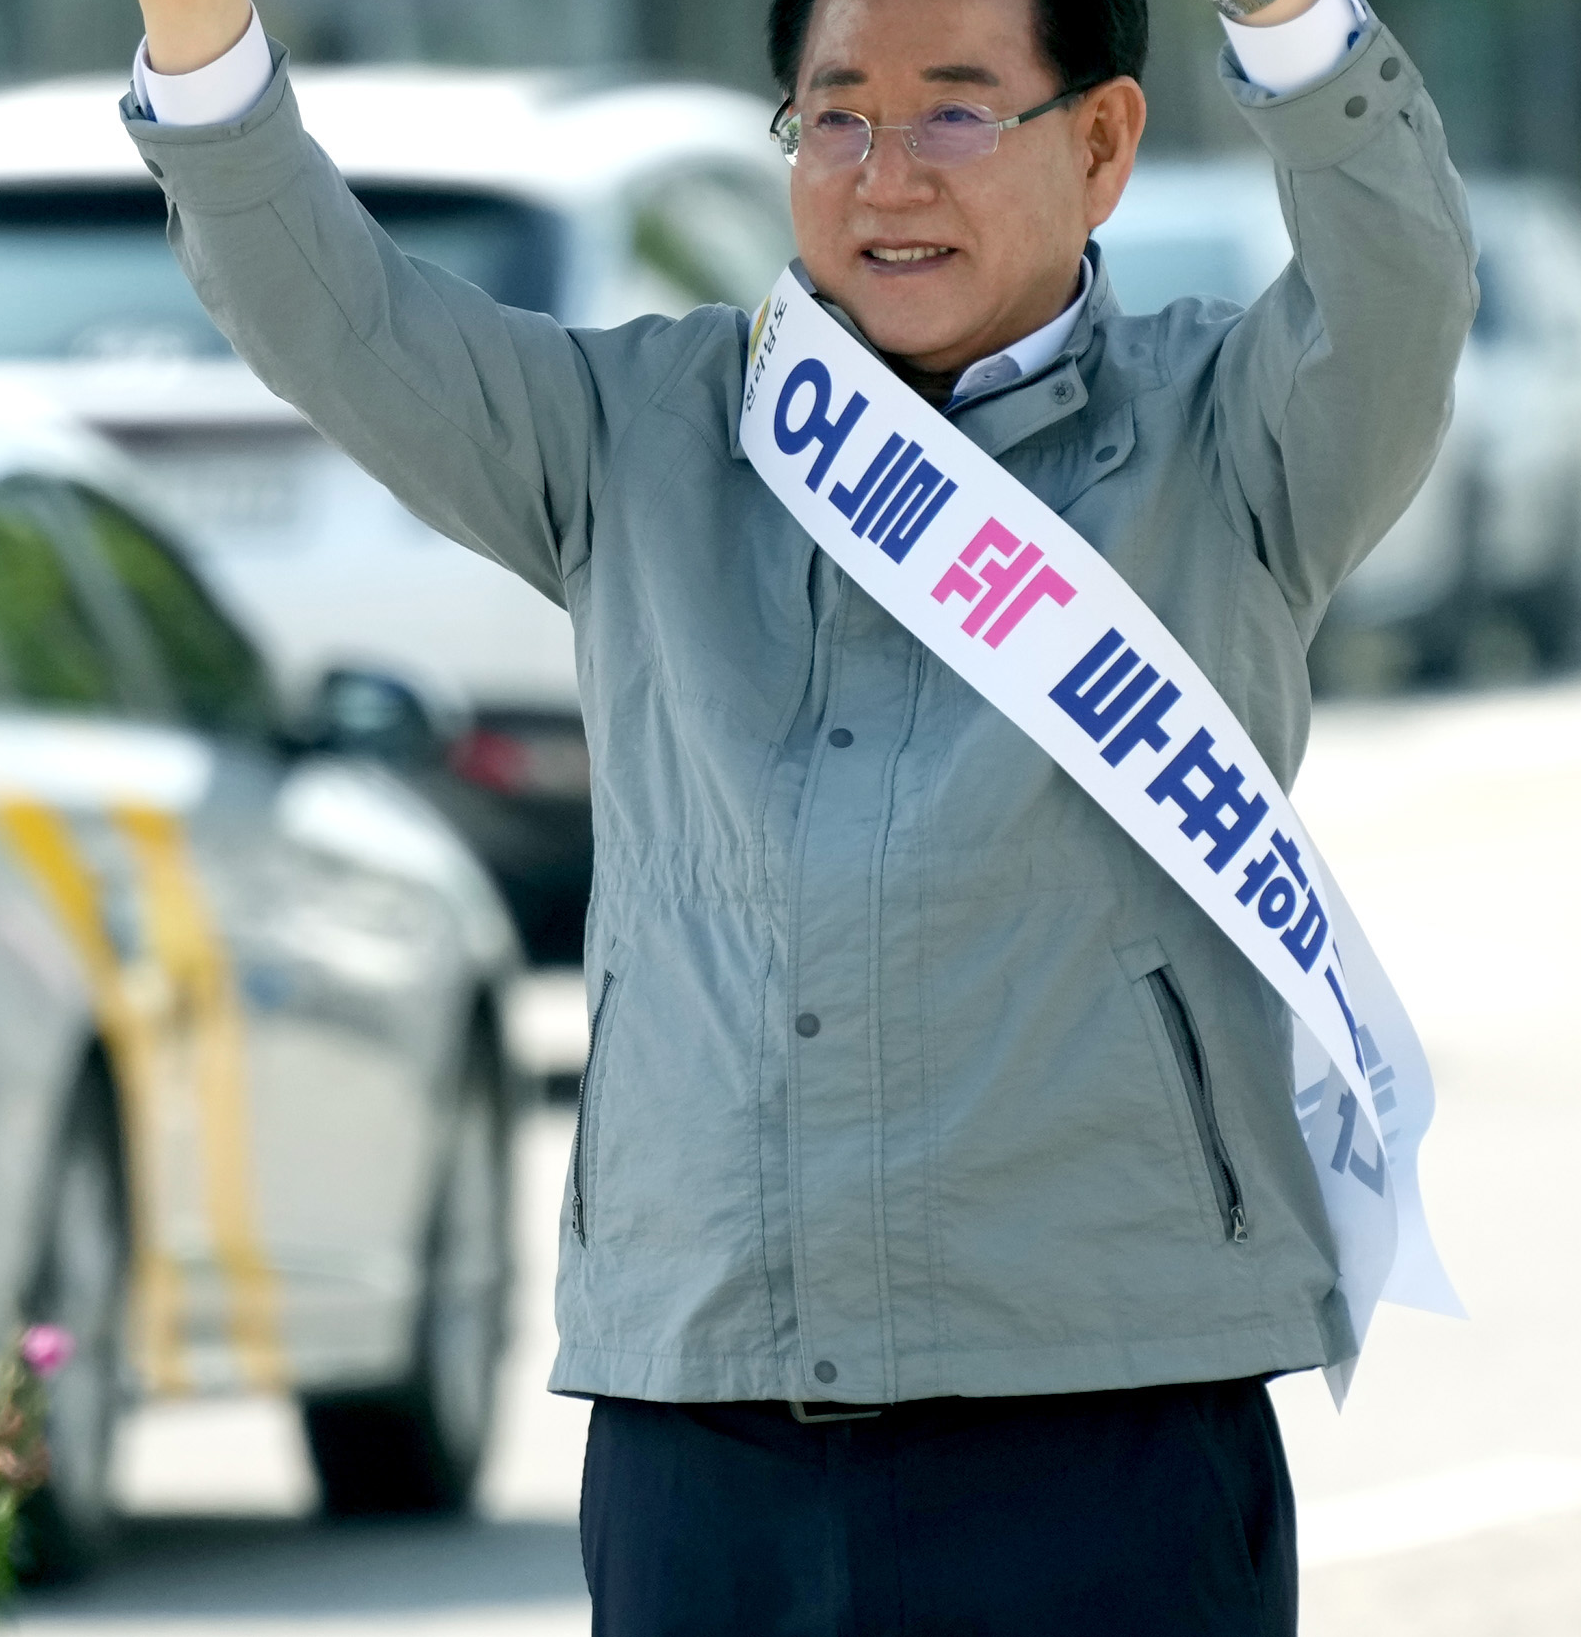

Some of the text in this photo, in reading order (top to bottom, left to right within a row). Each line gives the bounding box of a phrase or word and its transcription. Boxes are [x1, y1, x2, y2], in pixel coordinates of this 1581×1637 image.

[744, 296, 788, 414] 전라남도
[773, 358, 958, 564] 오늘
[931, 517, 1078, 650] 꼭
